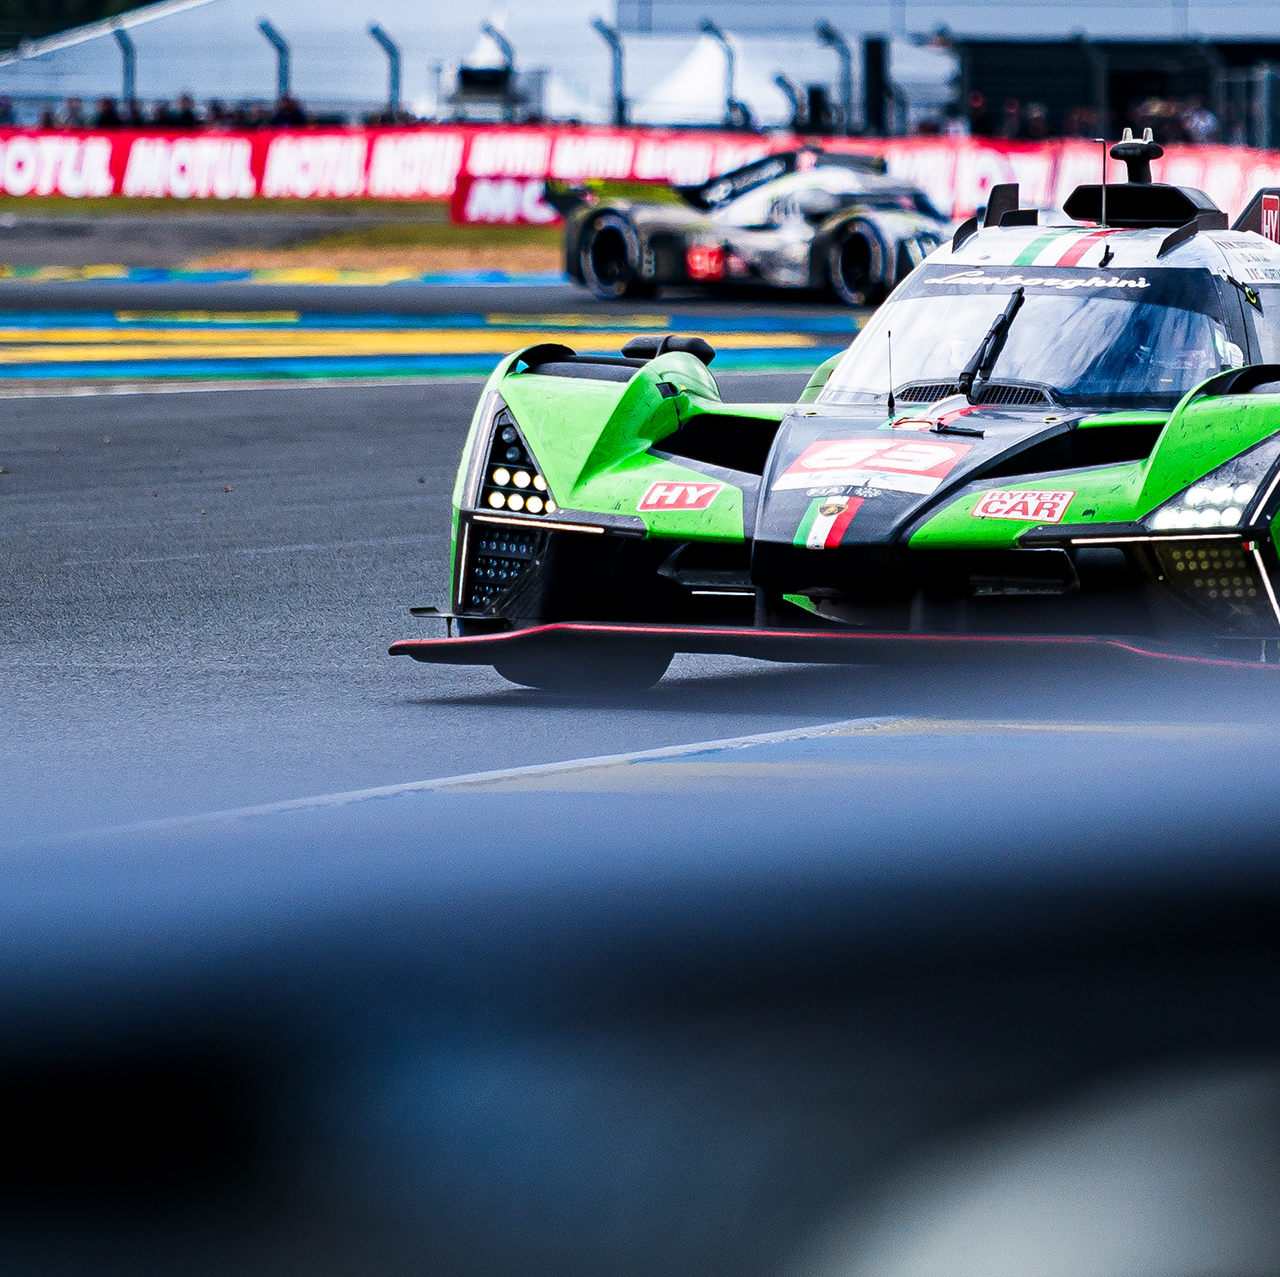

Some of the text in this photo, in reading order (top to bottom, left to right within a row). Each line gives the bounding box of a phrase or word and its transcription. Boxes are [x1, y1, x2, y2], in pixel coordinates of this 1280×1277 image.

[924, 271, 1151, 289] Lamborghini
[801, 442, 956, 472] 63
[646, 485, 717, 505] HY
[989, 492, 1066, 501] HYPER
[981, 500, 1060, 518] CAR
